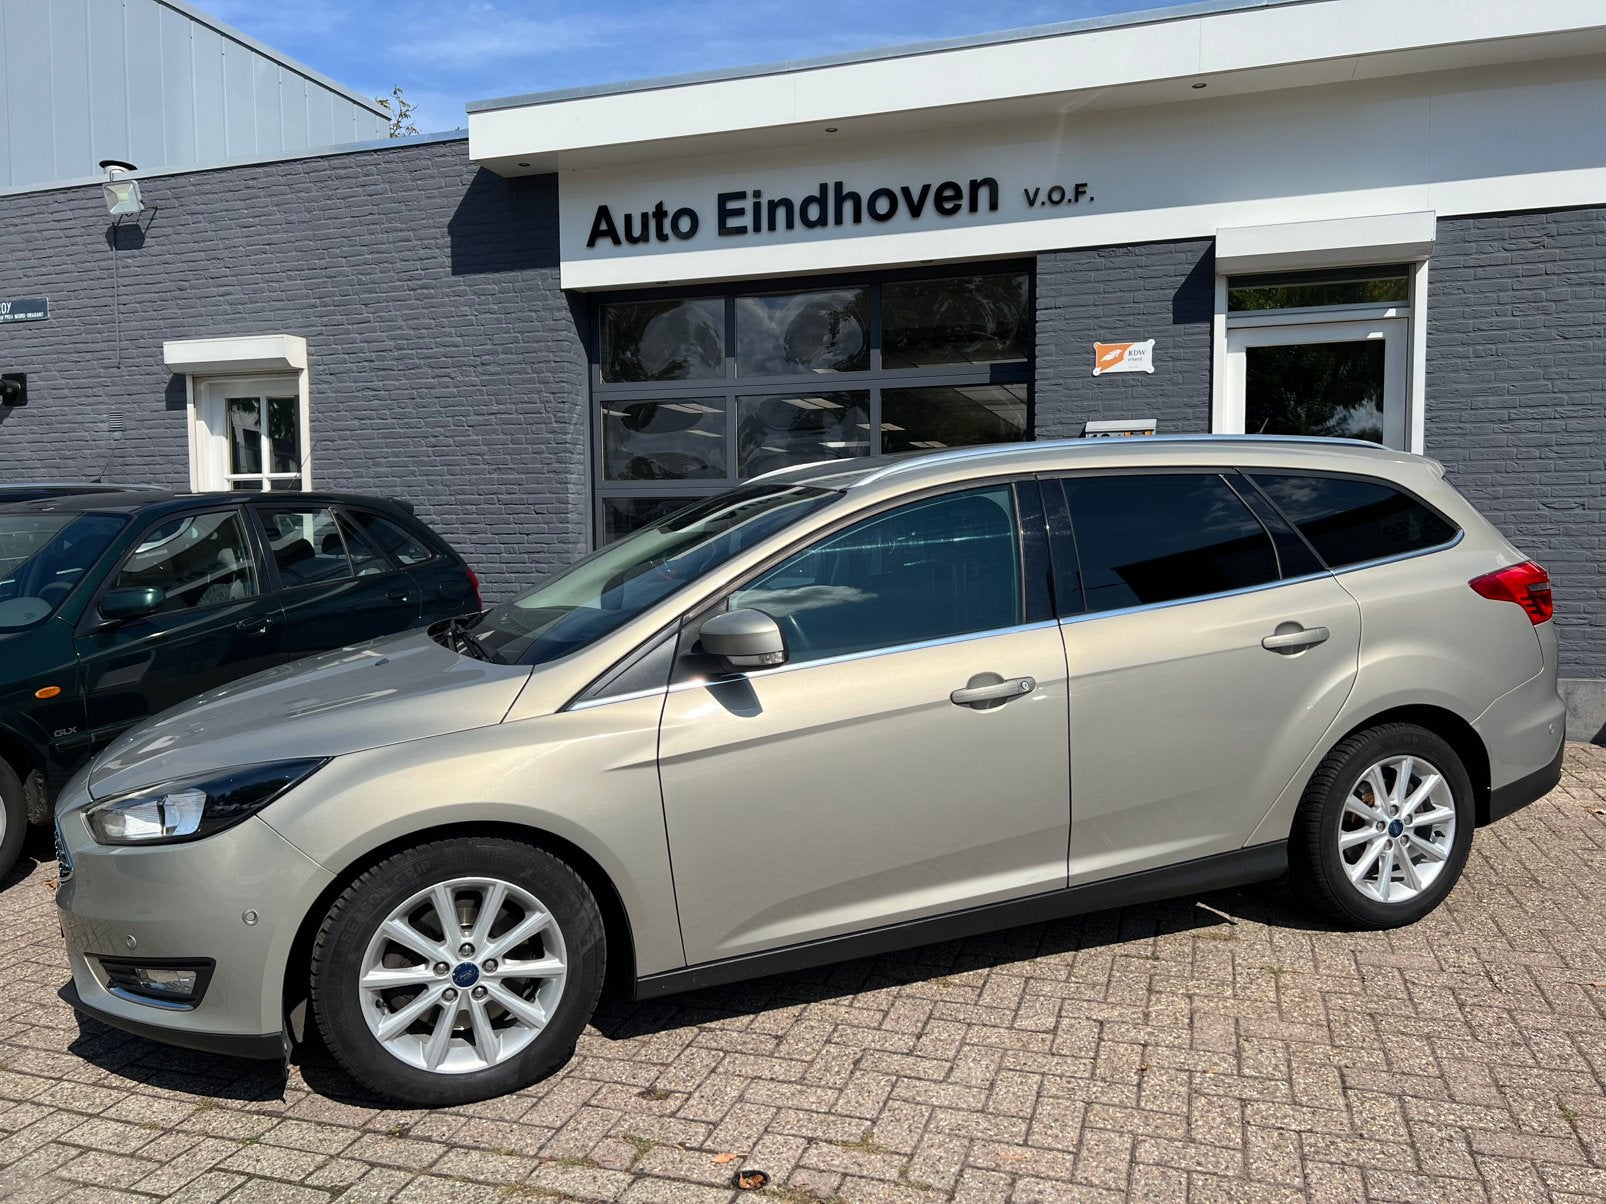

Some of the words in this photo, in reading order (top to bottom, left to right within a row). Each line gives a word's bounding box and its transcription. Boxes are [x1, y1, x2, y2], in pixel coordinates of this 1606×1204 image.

[586, 200, 699, 248] Auto
[717, 177, 999, 236] Eindhoven
[0, 302, 11, 313] OY
[54, 726, 77, 737] GLX
